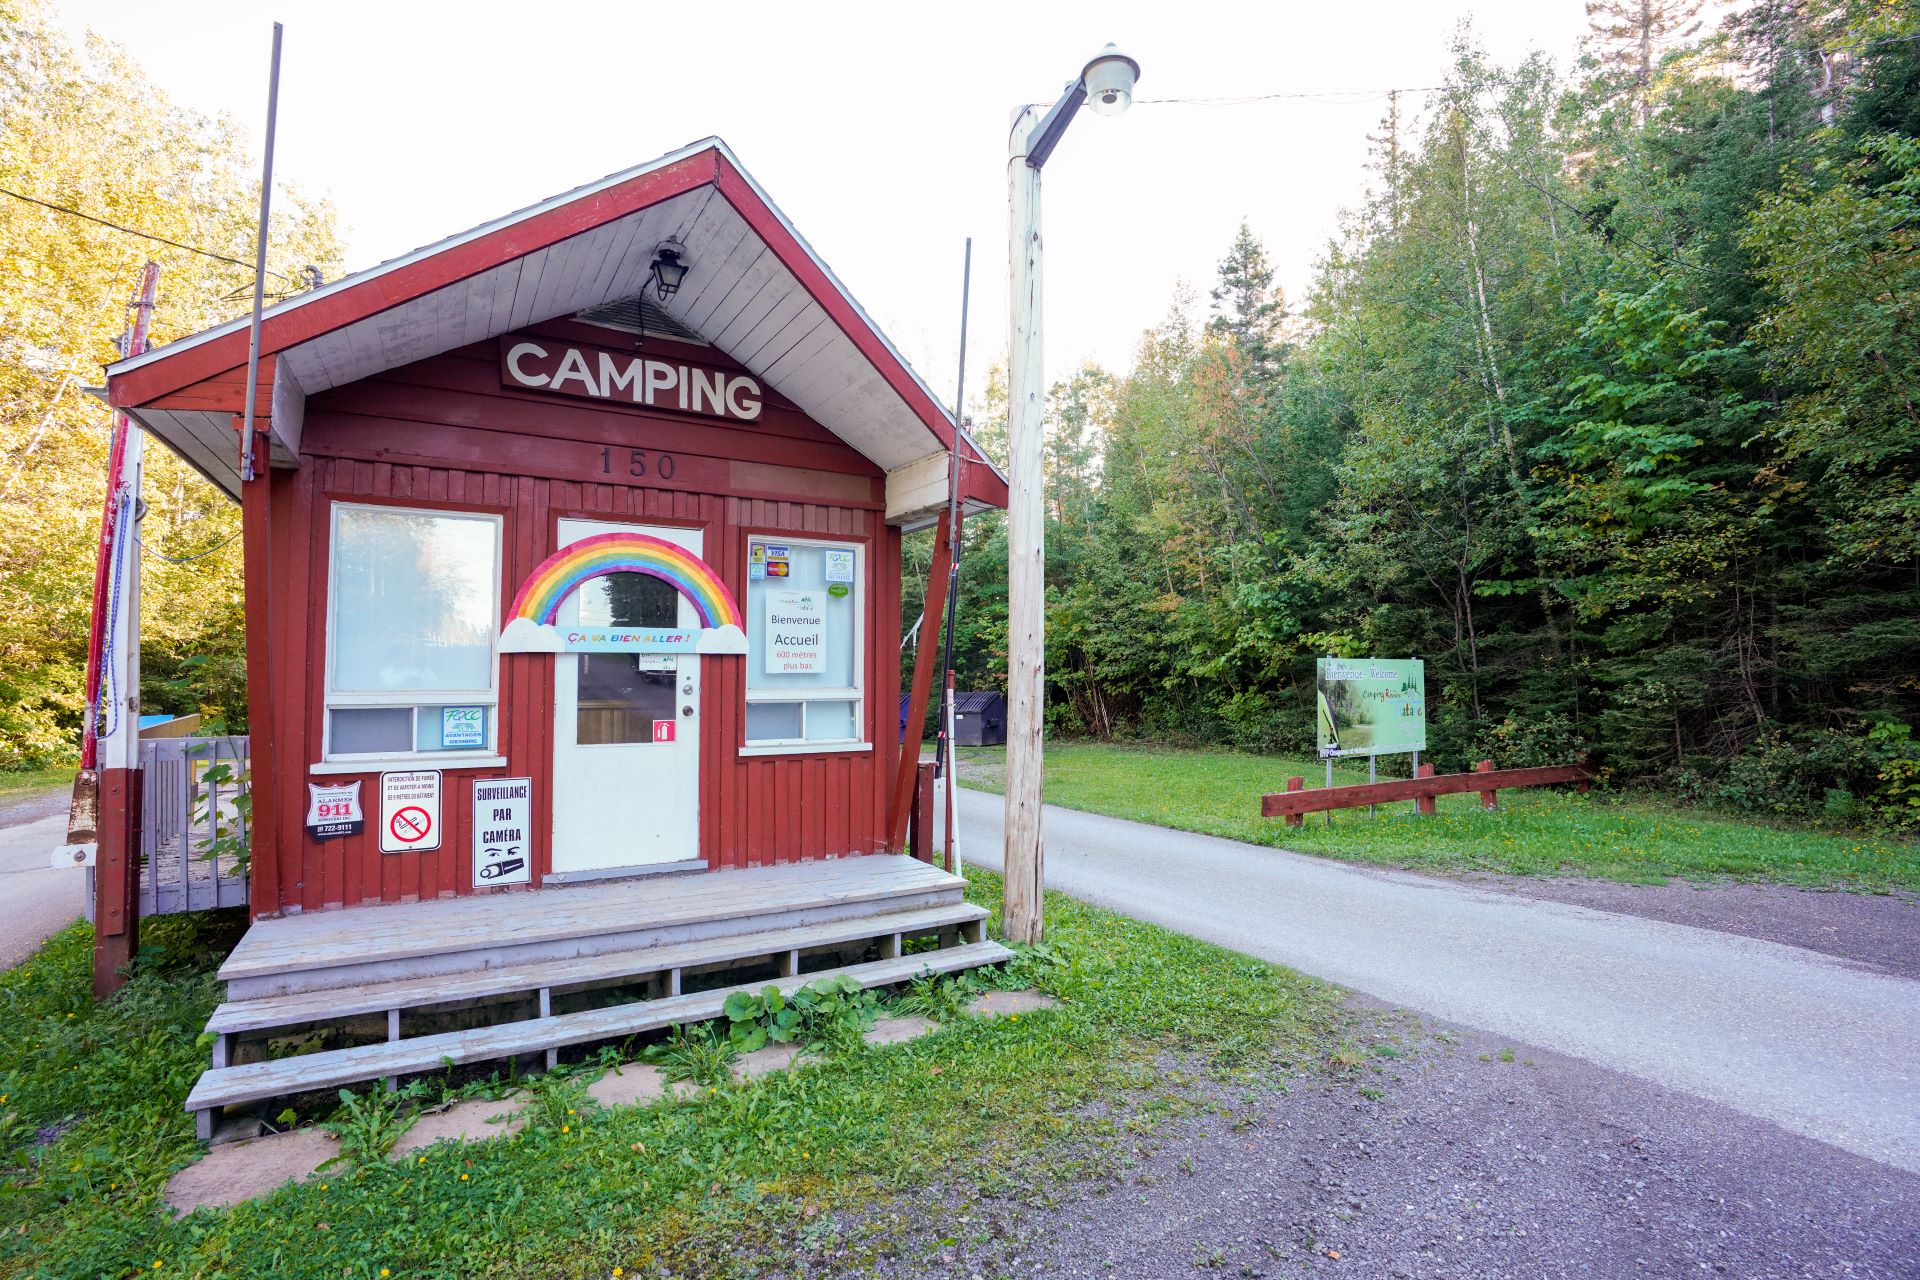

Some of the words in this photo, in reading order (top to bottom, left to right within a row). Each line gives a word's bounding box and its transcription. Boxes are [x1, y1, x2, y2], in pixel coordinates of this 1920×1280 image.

[506, 343, 762, 420] CAMPING
[600, 447, 675, 480] 150
[771, 614, 821, 625] Bienvenue
[567, 632, 587, 645] ÇA
[592, 634, 606, 642] VA
[610, 634, 641, 643] BIEN
[644, 634, 683, 643] ALLER
[774, 633, 819, 646] Accueil
[776, 651, 790, 659] 600
[783, 662, 798, 671] plus
[799, 662, 813, 670] bas
[1326, 668, 1362, 680] Bienvenue
[1370, 667, 1398, 680] Welcome
[477, 785, 528, 801] SURVEILLANCE
[317, 803, 353, 817] 911
[492, 807, 512, 822] PAR
[324, 824, 352, 832] 722-9111
[482, 827, 522, 844] CAMÉRA
